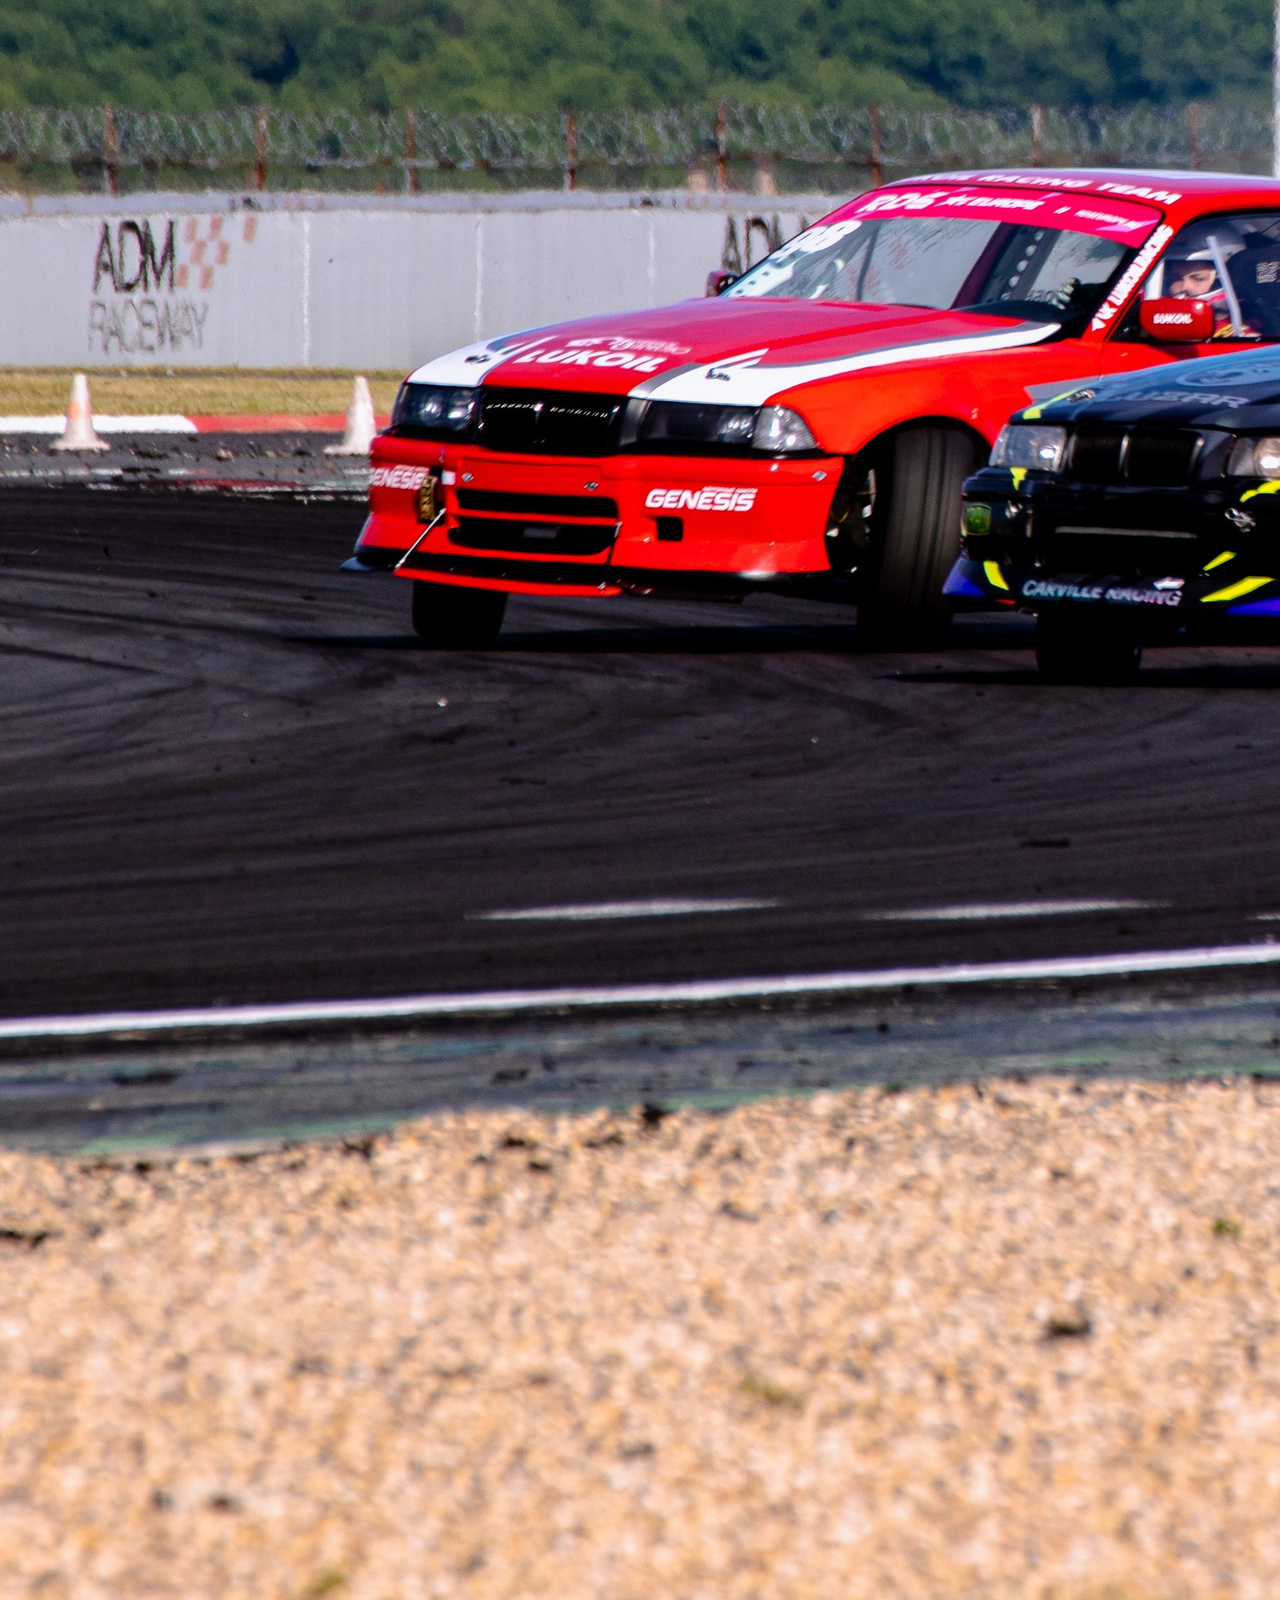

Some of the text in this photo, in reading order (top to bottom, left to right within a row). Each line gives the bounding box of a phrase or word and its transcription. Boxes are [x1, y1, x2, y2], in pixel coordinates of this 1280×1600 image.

[854, 190, 950, 213] RDS
[1096, 182, 1182, 205] TEAM
[92, 219, 175, 293] ADM
[512, 349, 668, 373] LUKOIL
[645, 488, 756, 512] GENESIS
[1022, 579, 1103, 598] CARVILLE
